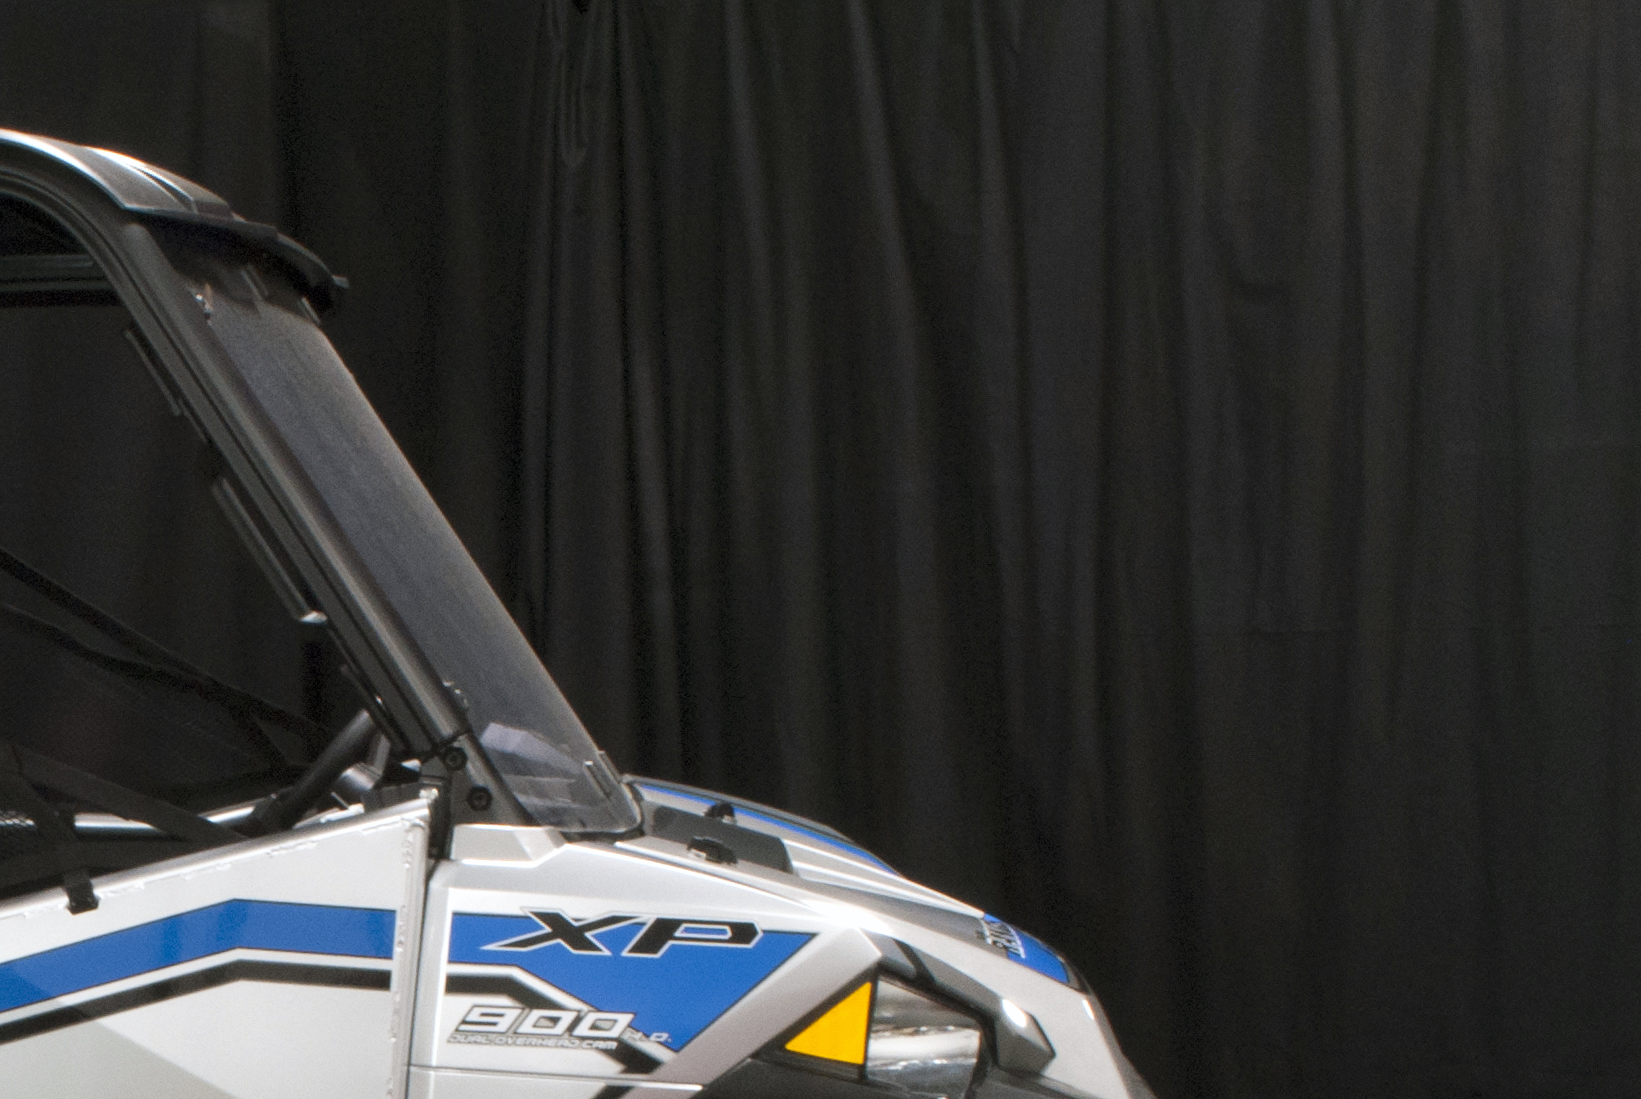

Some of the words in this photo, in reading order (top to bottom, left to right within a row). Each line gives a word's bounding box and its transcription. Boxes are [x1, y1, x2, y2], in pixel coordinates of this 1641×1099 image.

[480, 906, 764, 959] XP
[456, 1004, 637, 1040] 900
[448, 1033, 490, 1044] DUAL
[495, 1035, 579, 1049] OVERHEAD
[581, 1040, 619, 1051] CAM
